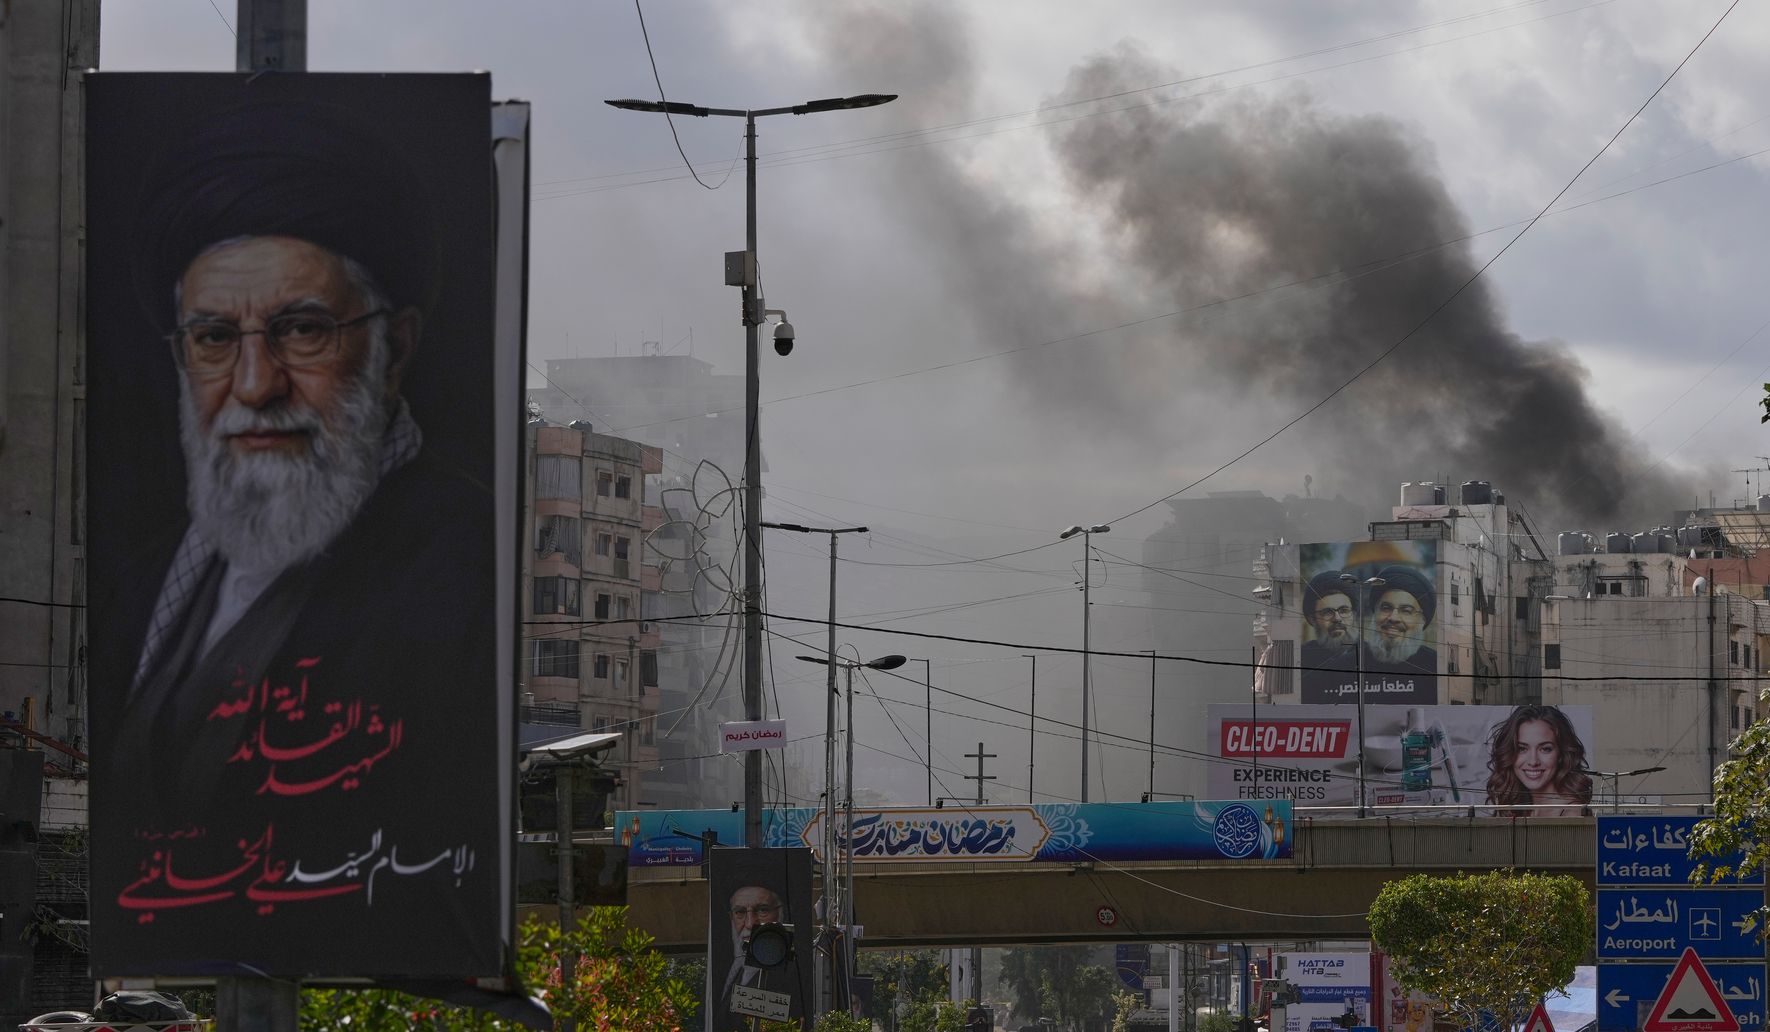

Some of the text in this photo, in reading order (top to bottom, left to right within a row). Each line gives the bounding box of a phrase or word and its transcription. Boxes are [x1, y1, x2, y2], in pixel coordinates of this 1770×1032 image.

[272, 656, 321, 721] آية
[226, 698, 362, 764] القائد
[725, 730, 782, 741] رمضان كريم
[1227, 726, 1341, 752] CLEO-DENT
[1233, 768, 1331, 783] EXPERIENCE
[1239, 786, 1326, 800] FRESHNESS
[922, 818, 1016, 855] رمضان
[1603, 861, 1672, 878] Kafaat
[1603, 896, 1679, 930] المطار
[1604, 936, 1676, 952] Aeroport
